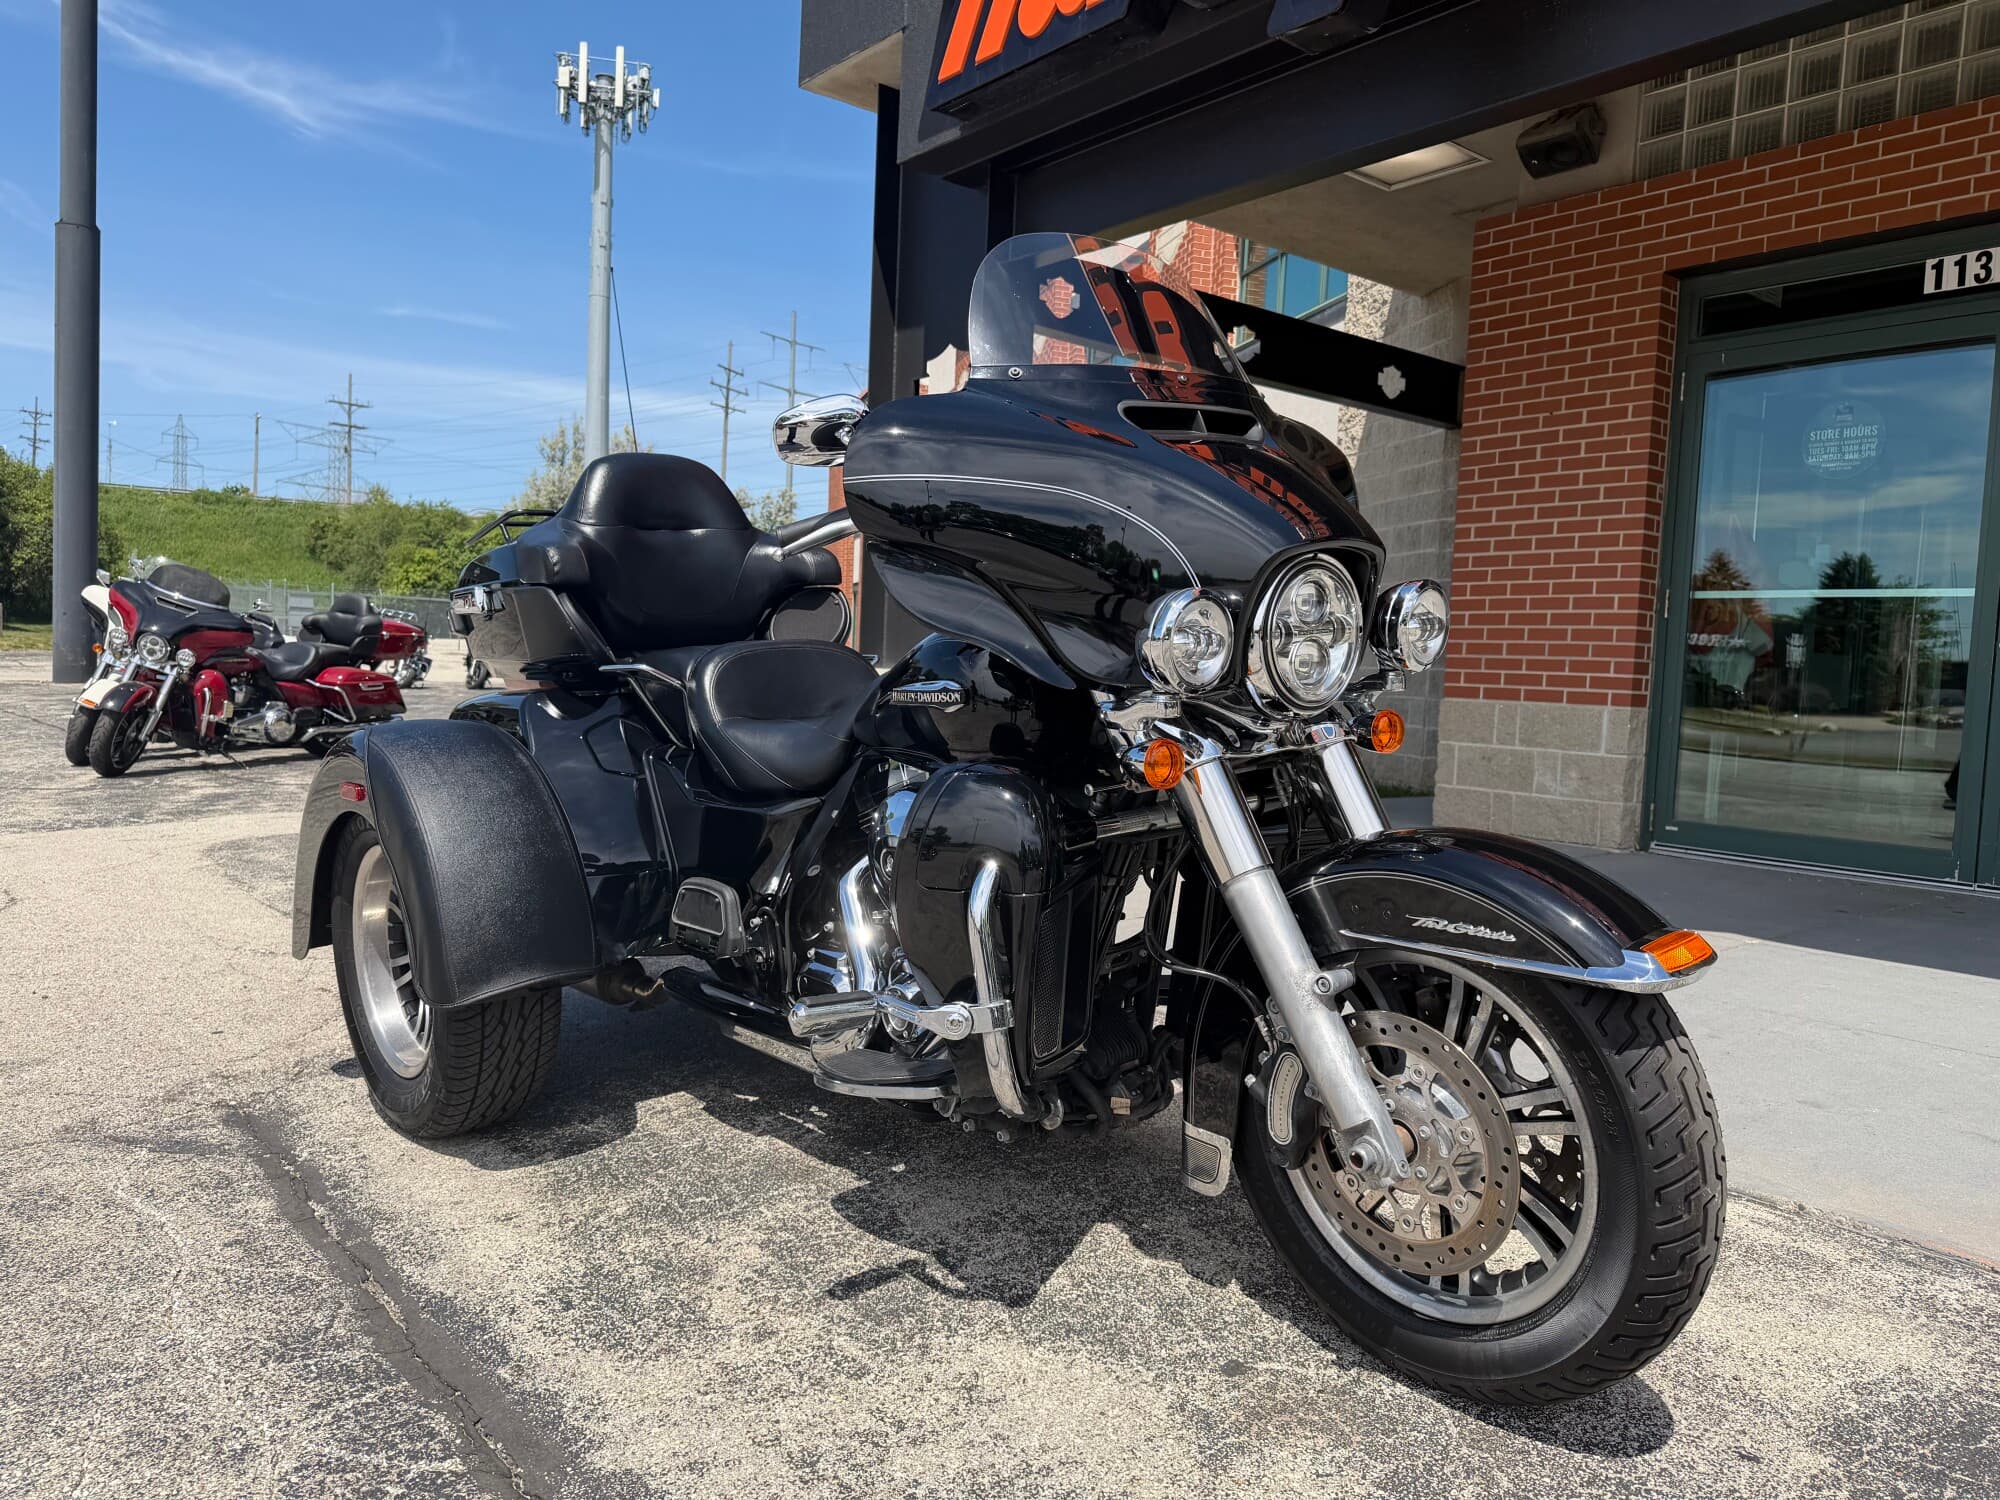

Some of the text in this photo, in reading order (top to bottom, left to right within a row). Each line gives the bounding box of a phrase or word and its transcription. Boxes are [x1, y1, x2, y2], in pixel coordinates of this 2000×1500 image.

[1930, 250, 1993, 291] 113
[1809, 424, 1878, 441] STORE HOURS
[892, 690, 961, 703] HARLEY-DAVIDSON
